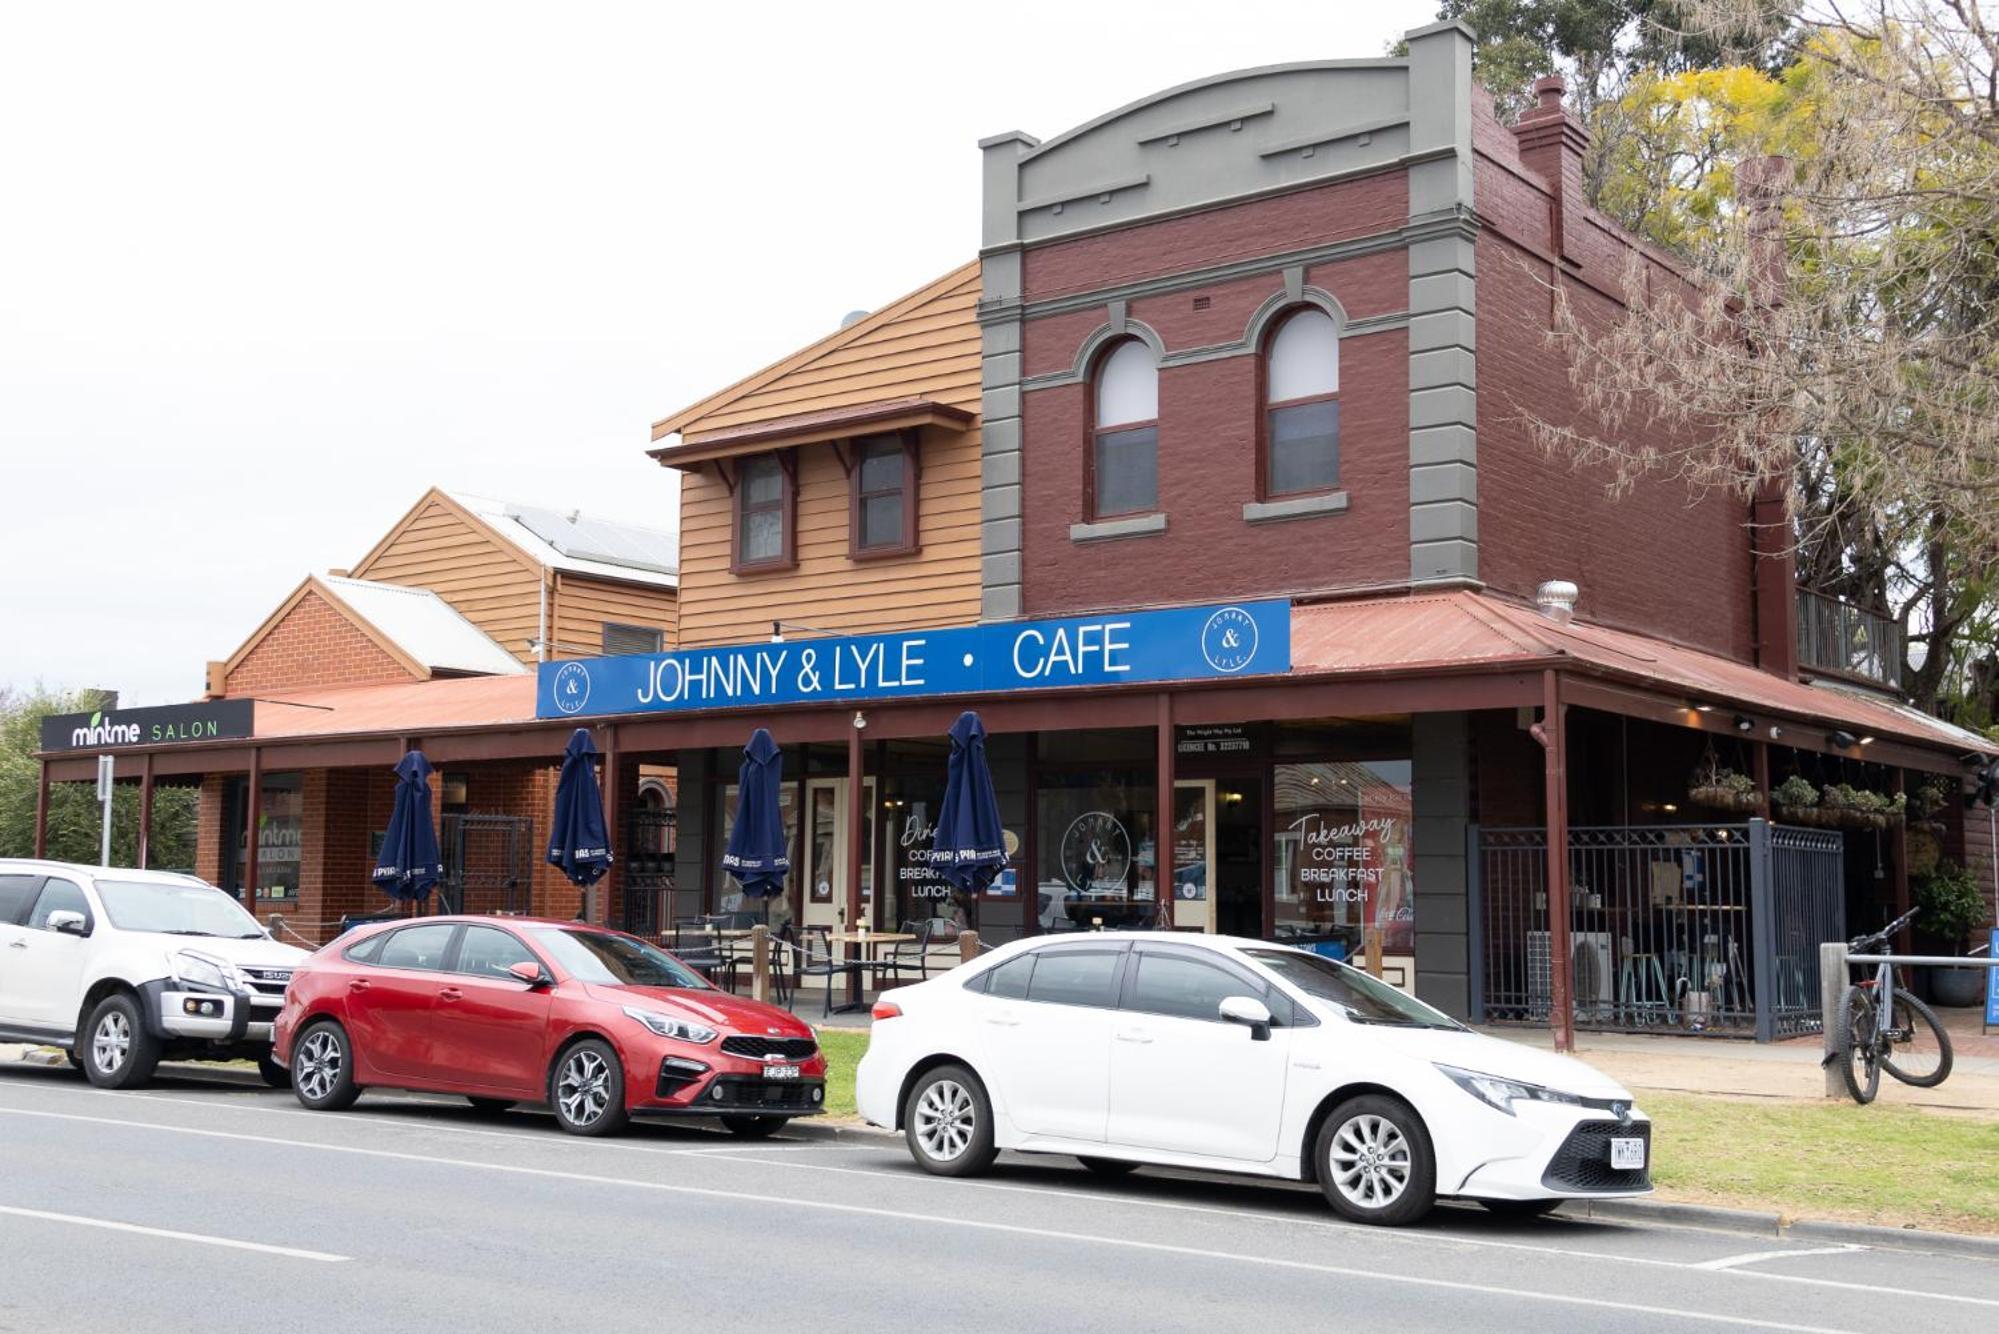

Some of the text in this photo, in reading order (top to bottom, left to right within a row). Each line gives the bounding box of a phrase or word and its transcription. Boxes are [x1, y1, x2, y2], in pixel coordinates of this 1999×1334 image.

[1222, 628, 1240, 648] &
[637, 622, 1131, 704] JOHNNY & LYLE CAFE
[566, 679, 579, 694] &
[72, 714, 217, 747] mintme SALON
[1288, 813, 1397, 851] Takeaway
[1086, 839, 1108, 864] &
[1312, 847, 1371, 860] COFFEE
[1301, 868, 1384, 881] BREAKFAST
[912, 885, 951, 898] LUNCH
[1317, 888, 1368, 902] LUNCH
